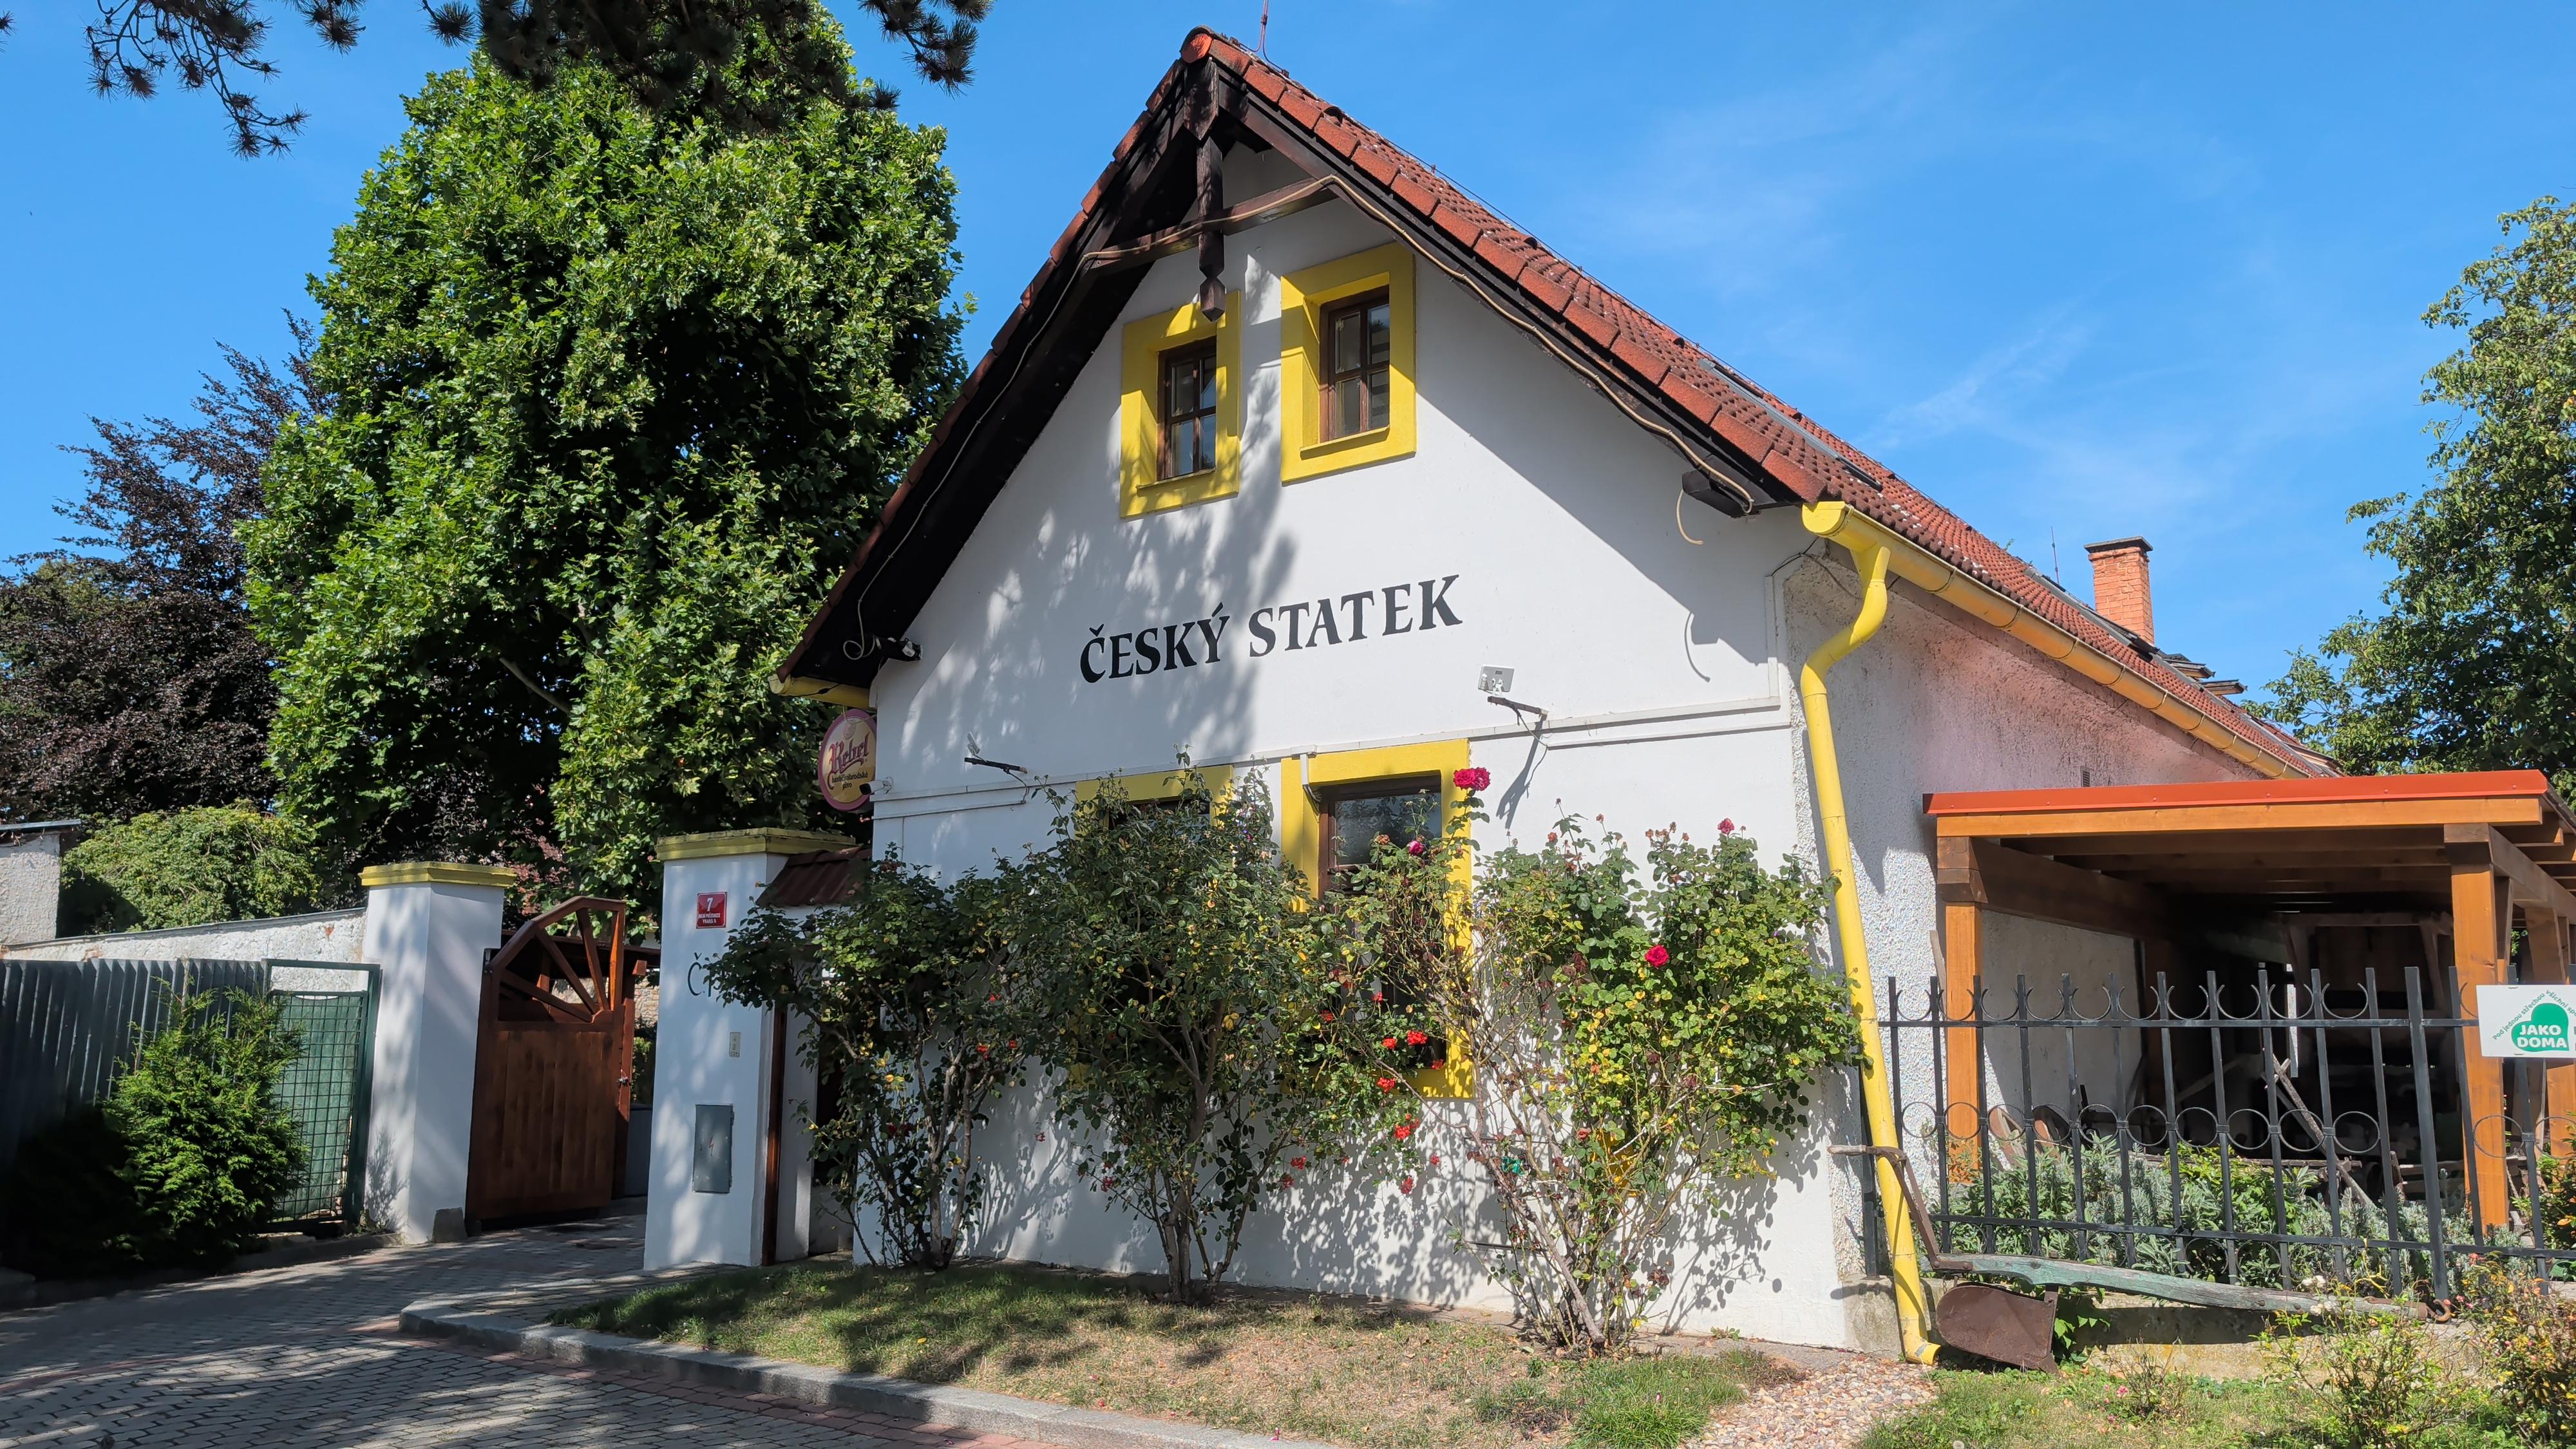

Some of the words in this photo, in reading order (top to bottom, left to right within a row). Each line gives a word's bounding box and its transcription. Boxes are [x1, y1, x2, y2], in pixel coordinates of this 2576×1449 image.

[1080, 602, 1230, 683] ČESKÝ
[1248, 574, 1463, 658] STATEK
[842, 781, 852, 790] pivo
[706, 897, 714, 912] 7
[2492, 1029, 2504, 1040] Pod
[2503, 1014, 2522, 1032] jednou
[2521, 992, 2545, 1015] střechou
[2546, 989, 2569, 1008] všichni
[2519, 1025, 2561, 1036] JAKO
[2517, 1037, 2567, 1048] DOMA
